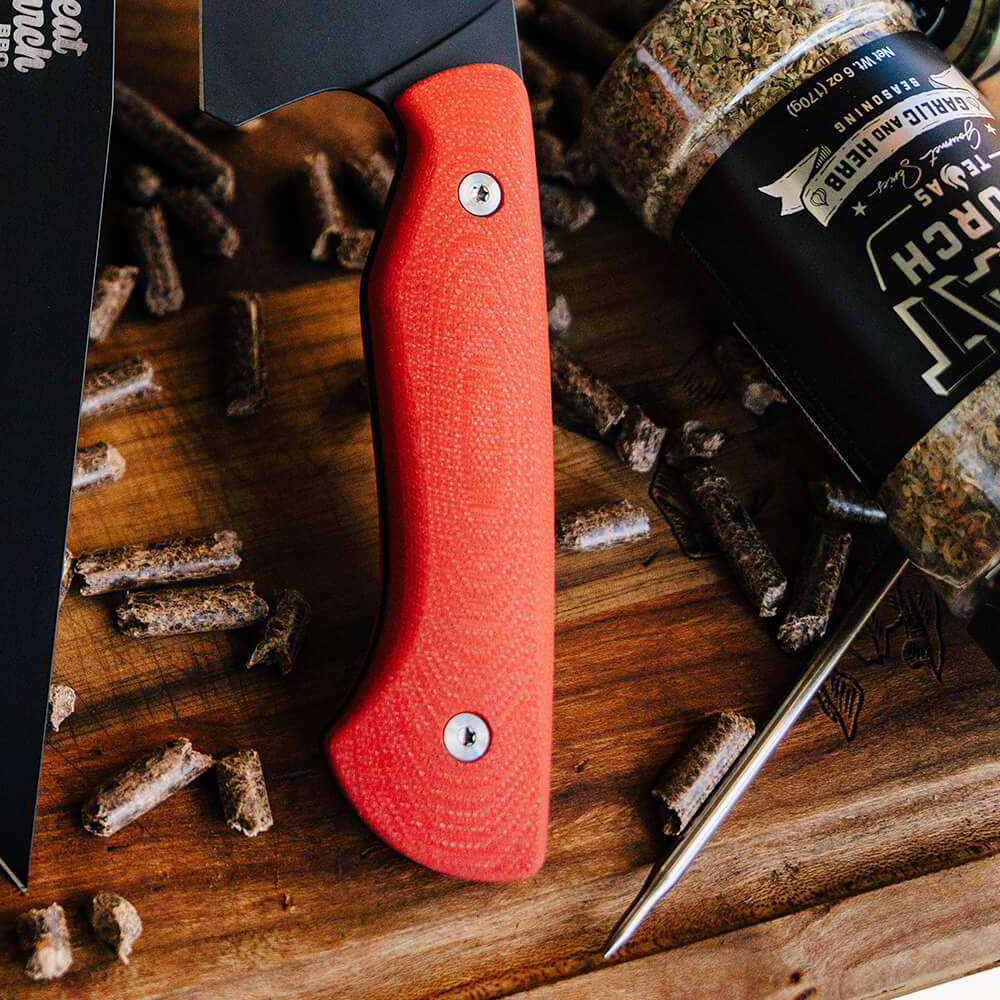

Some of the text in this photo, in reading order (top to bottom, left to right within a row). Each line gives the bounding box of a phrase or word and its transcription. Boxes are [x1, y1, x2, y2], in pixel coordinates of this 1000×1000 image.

[843, 67, 855, 78] 6
[872, 46, 896, 63] Net
[826, 72, 844, 88] oz
[786, 82, 829, 118] (170g)
[834, 77, 920, 133] SEASONING
[824, 96, 970, 192] GARLIC AND HERB
[919, 119, 981, 168] Gourmet
